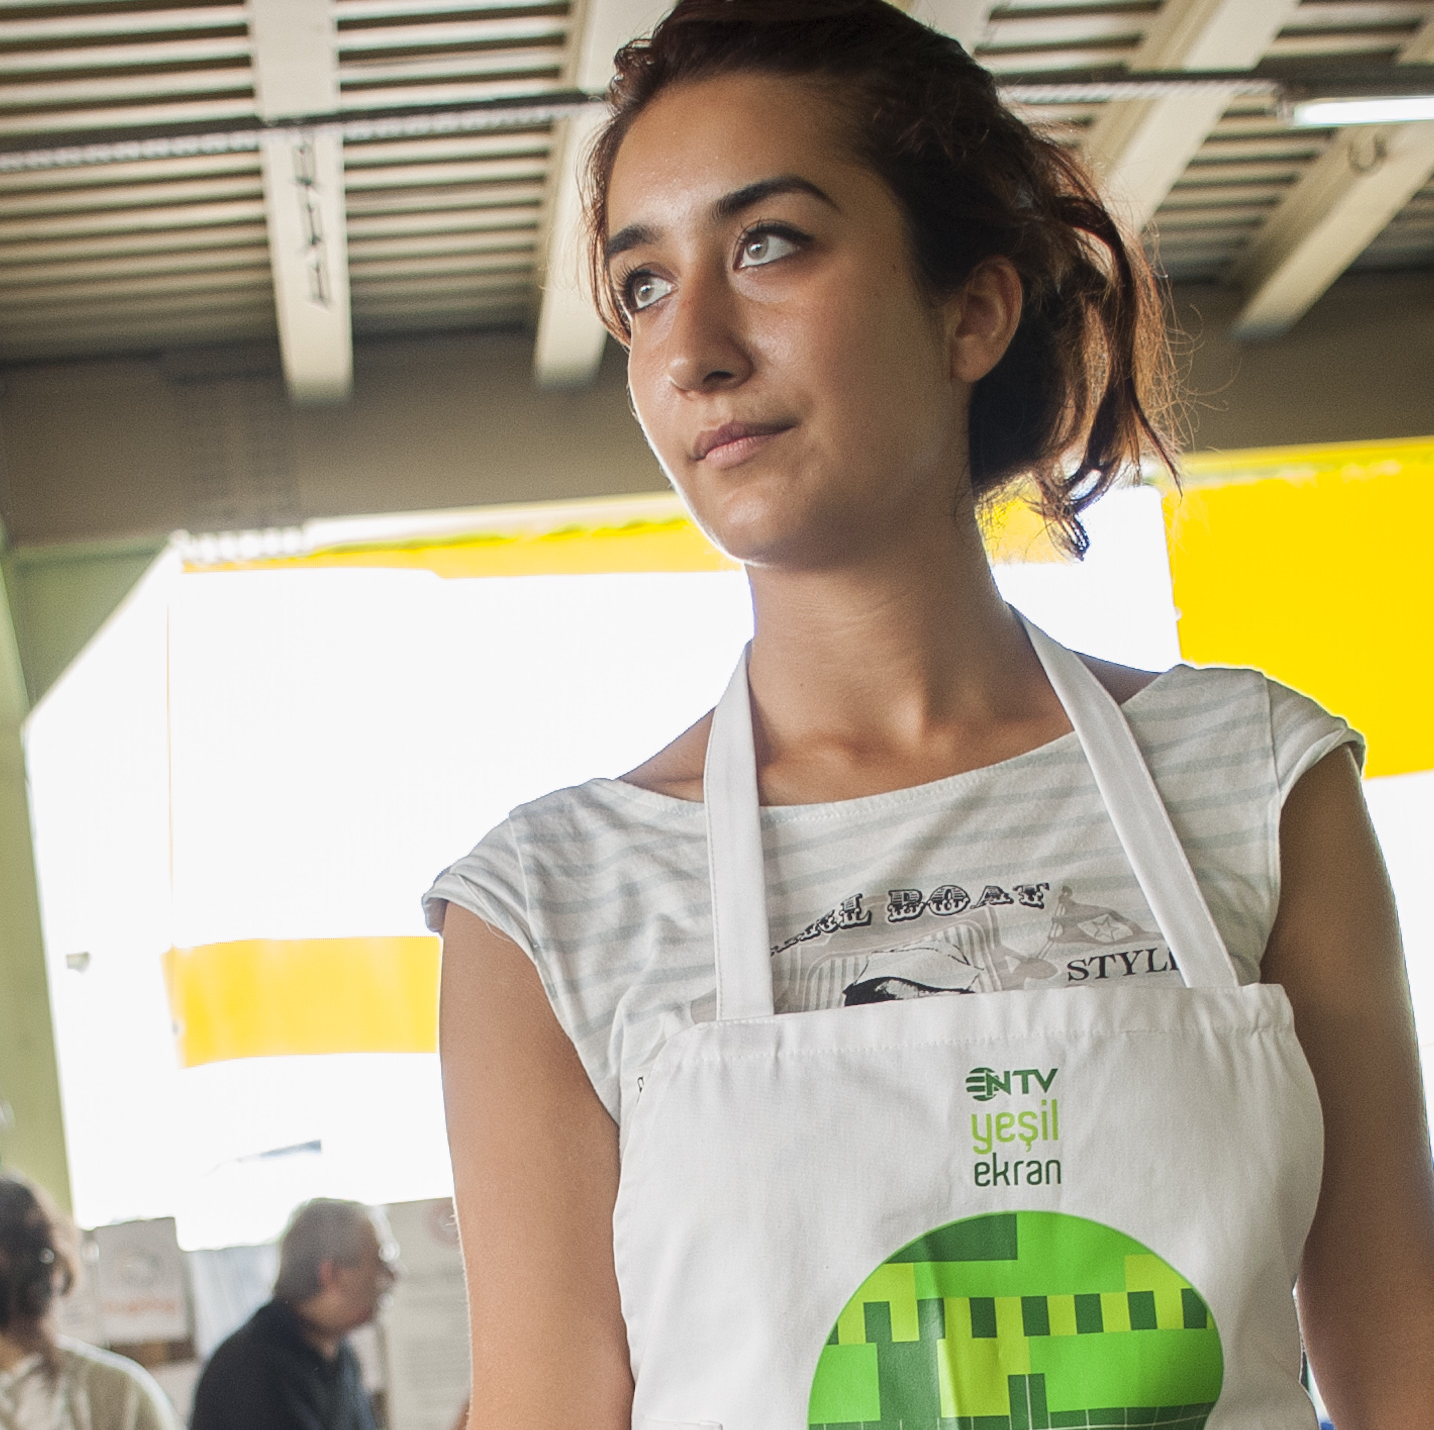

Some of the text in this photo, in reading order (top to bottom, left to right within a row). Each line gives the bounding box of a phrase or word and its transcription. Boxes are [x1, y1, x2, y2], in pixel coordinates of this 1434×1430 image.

[887, 883, 1051, 923] BOAT
[985, 1067, 1058, 1097] NTV
[970, 1099, 1059, 1155] yeşil
[974, 1152, 1062, 1187] ekran
